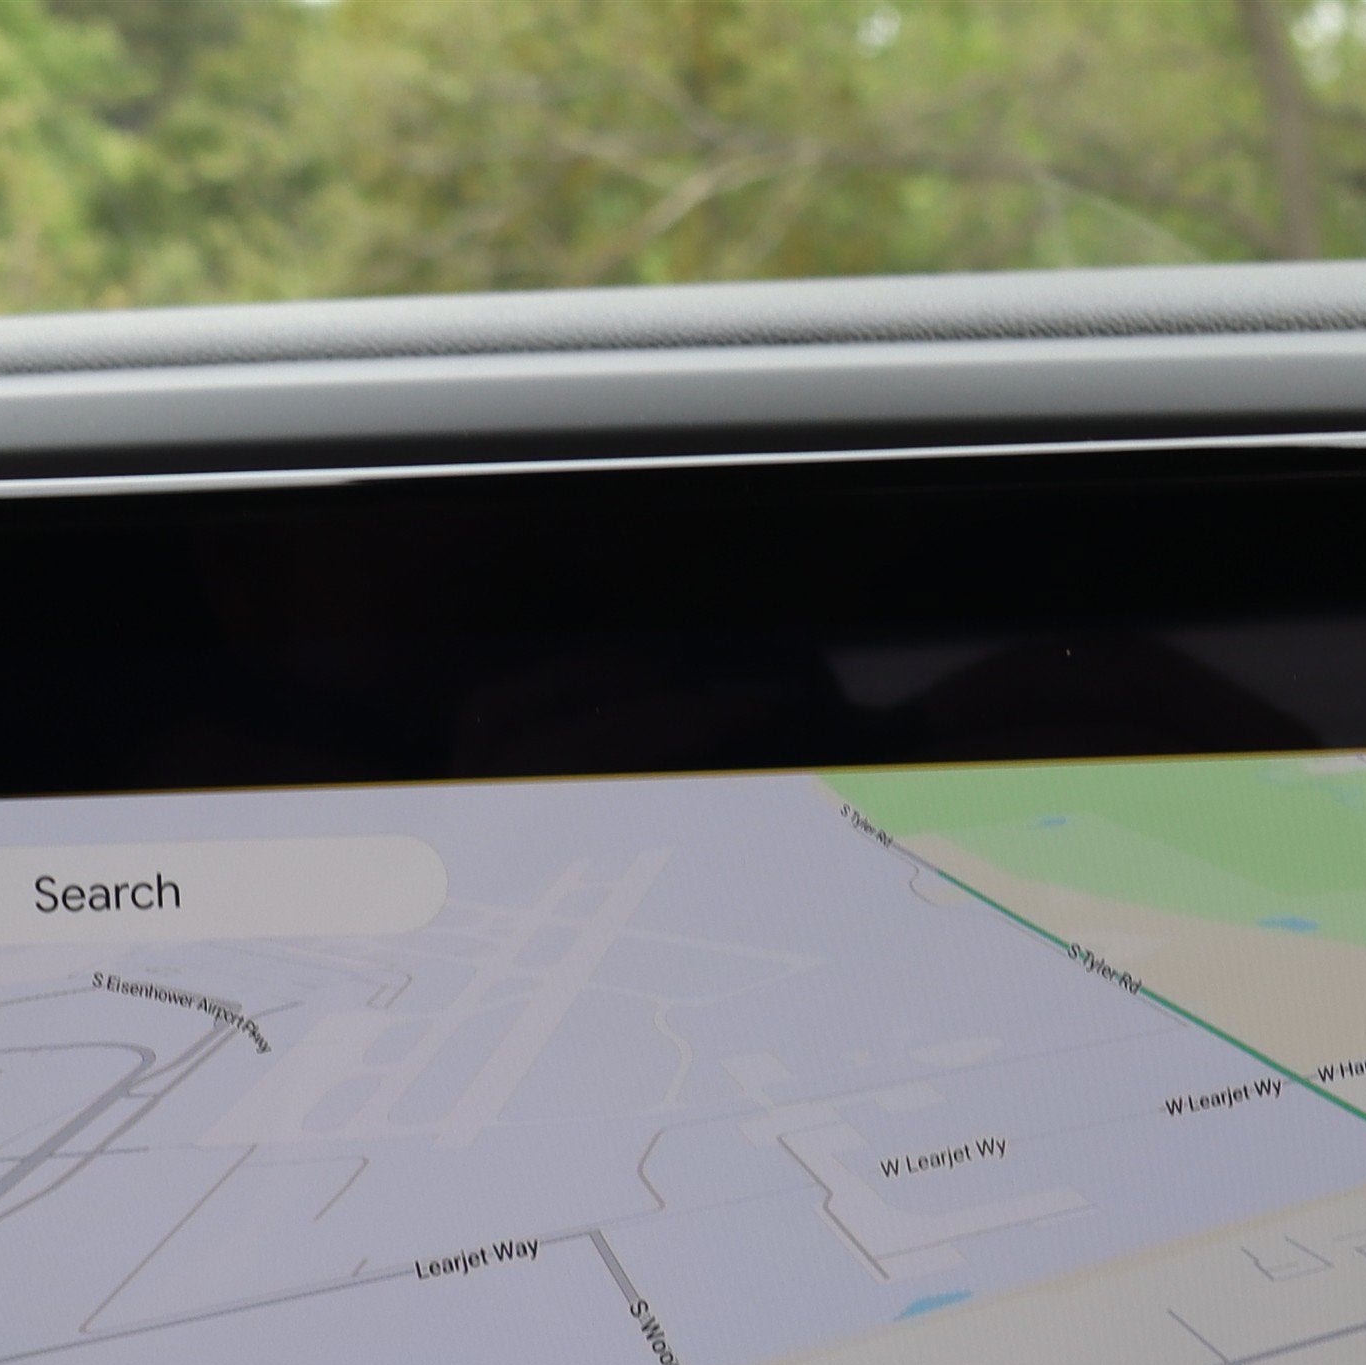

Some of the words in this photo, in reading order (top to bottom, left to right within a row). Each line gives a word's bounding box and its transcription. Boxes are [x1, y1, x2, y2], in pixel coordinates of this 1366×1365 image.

[34, 872, 181, 913] Search
[1067, 943, 1081, 960] S
[1082, 950, 1118, 981] Tyler
[1118, 971, 1143, 995] Rd
[91, 971, 103, 988] S
[107, 975, 195, 1009] Eisenhower
[196, 996, 244, 1029] Airport
[1317, 1065, 1336, 1082] W
[1165, 1097, 1184, 1116] W
[1188, 1082, 1251, 1110] Learjet
[1253, 1078, 1283, 1100] Wy
[881, 1158, 899, 1178] W
[906, 1144, 973, 1174] Learjet
[975, 1136, 1007, 1160] Wy
[414, 1245, 489, 1280] Learjet
[493, 1238, 540, 1263] Way
[630, 1299, 649, 1319] S
